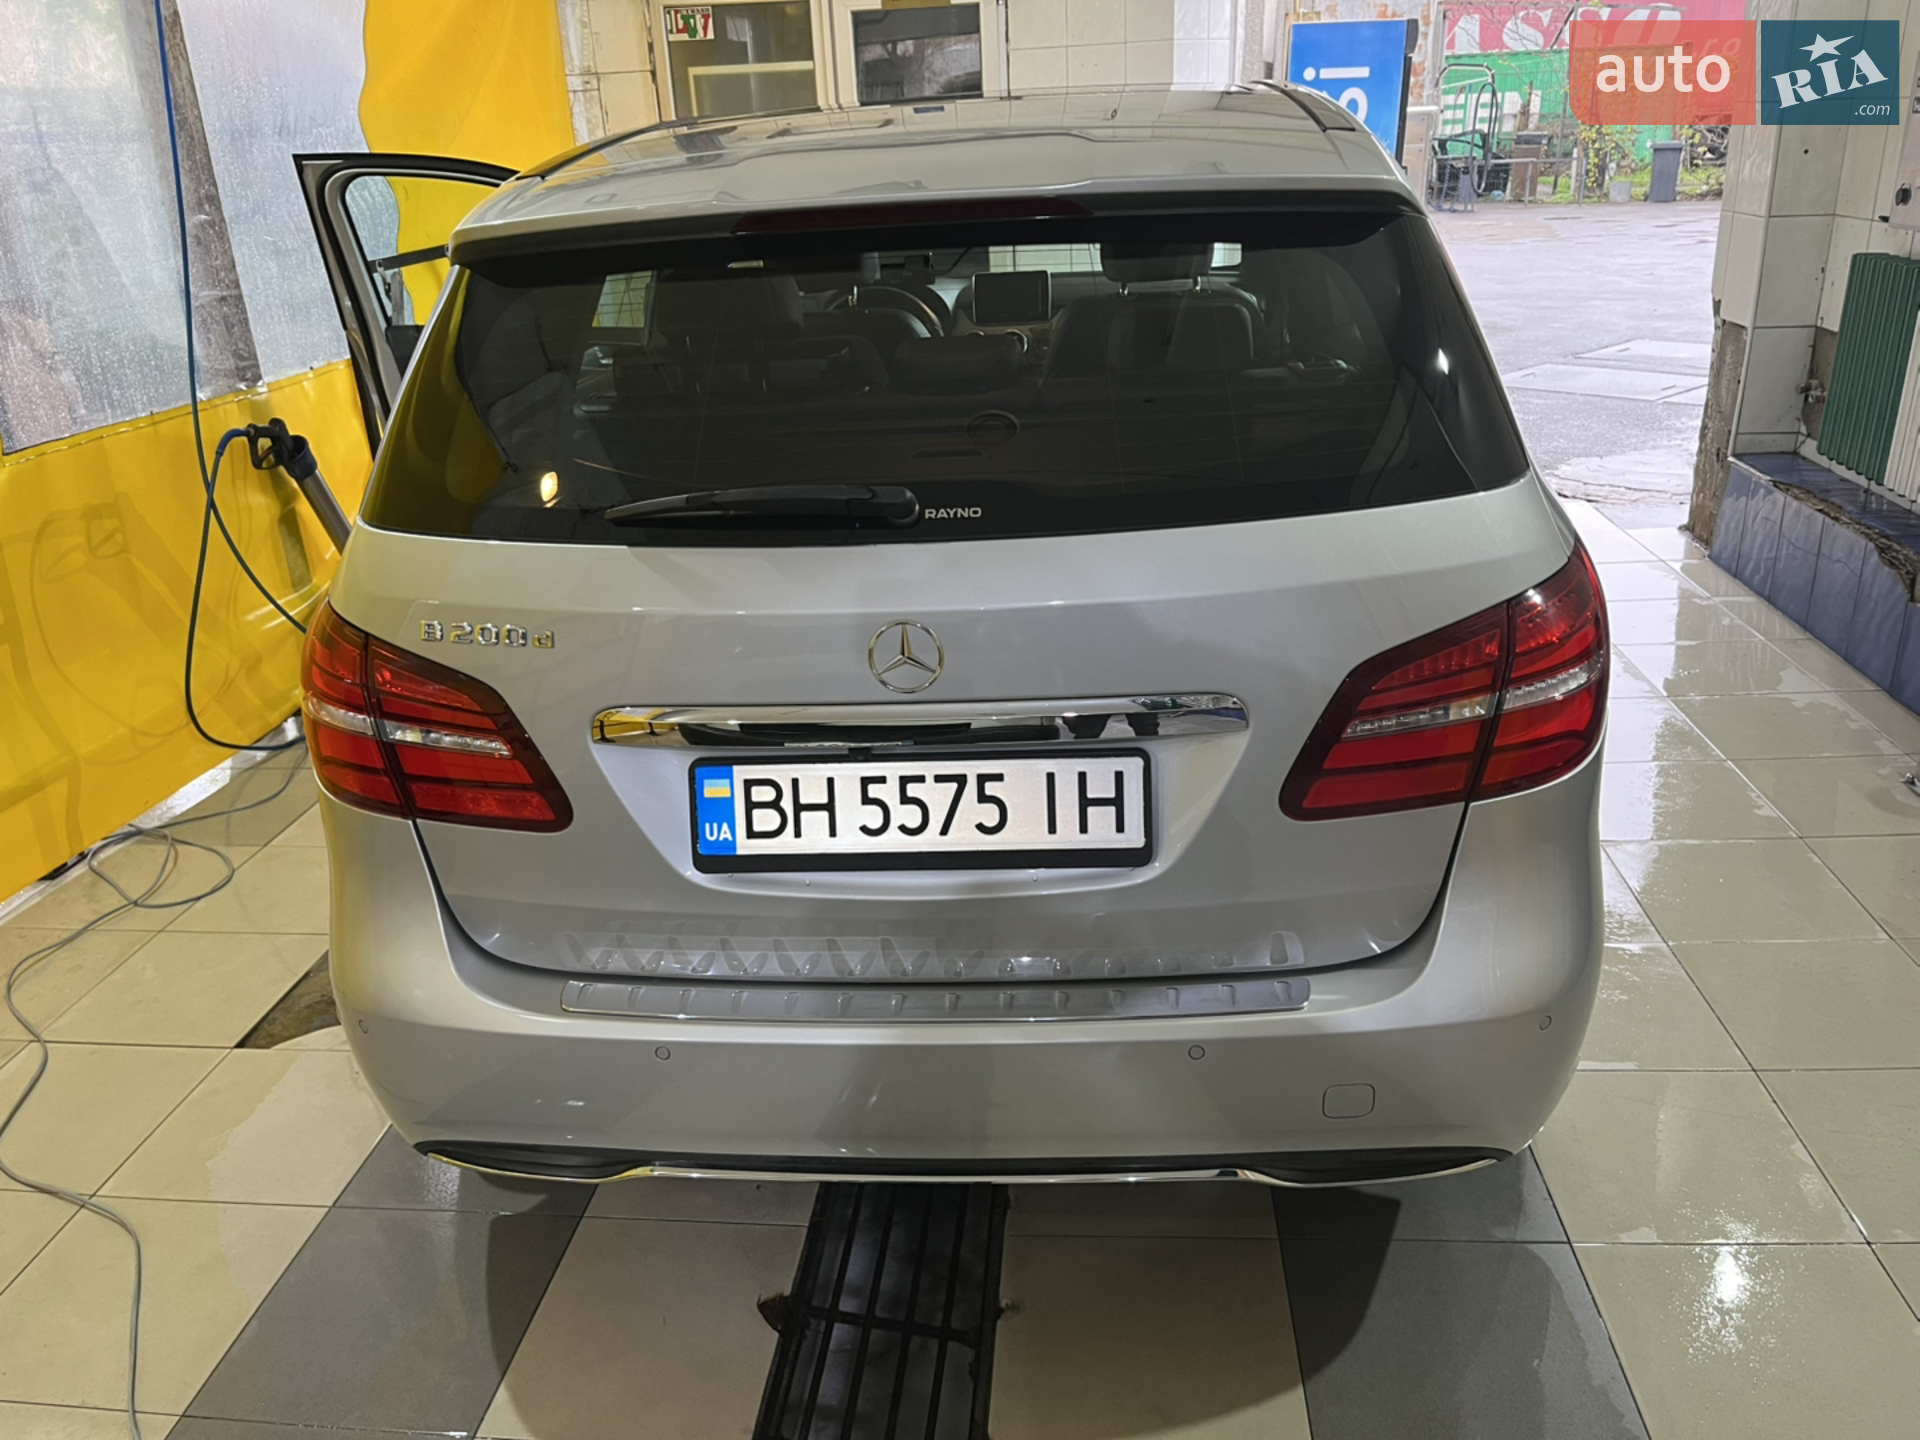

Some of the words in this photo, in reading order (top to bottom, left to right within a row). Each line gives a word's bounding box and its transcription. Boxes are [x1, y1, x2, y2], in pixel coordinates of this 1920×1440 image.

[924, 507, 983, 520] RAYNO
[420, 619, 444, 642] B
[743, 776, 837, 840] BH
[858, 773, 1009, 838] 5575
[1045, 770, 1126, 835] IH
[704, 822, 733, 842] UA
